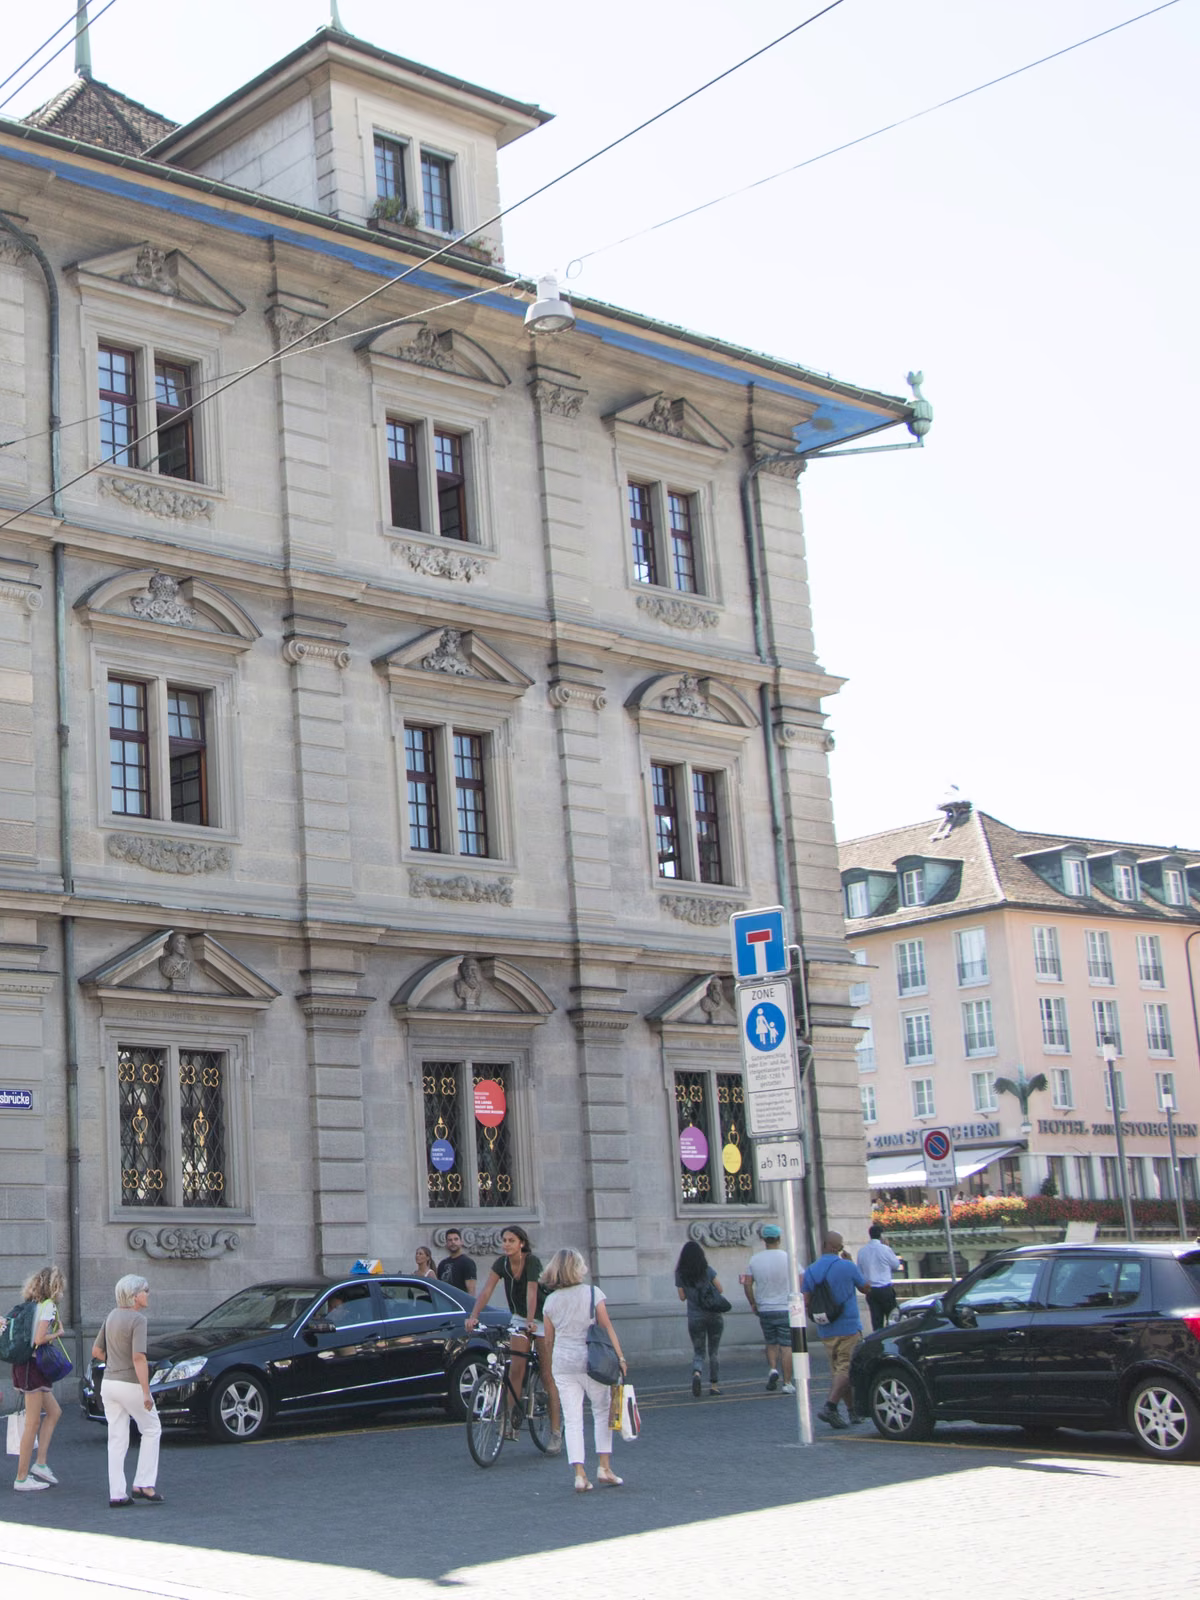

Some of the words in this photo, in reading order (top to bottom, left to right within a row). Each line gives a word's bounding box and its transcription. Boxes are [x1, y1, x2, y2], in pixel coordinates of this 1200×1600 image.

[751, 988, 775, 1000] ZONE
[1037, 1119, 1089, 1135] HOTEL
[1120, 1121, 1198, 1137] STORCHEN
[873, 1133, 904, 1148] ZUM
[761, 1157, 773, 1169] ab
[777, 1153, 787, 1167] 13
[790, 1157, 799, 1166] m
